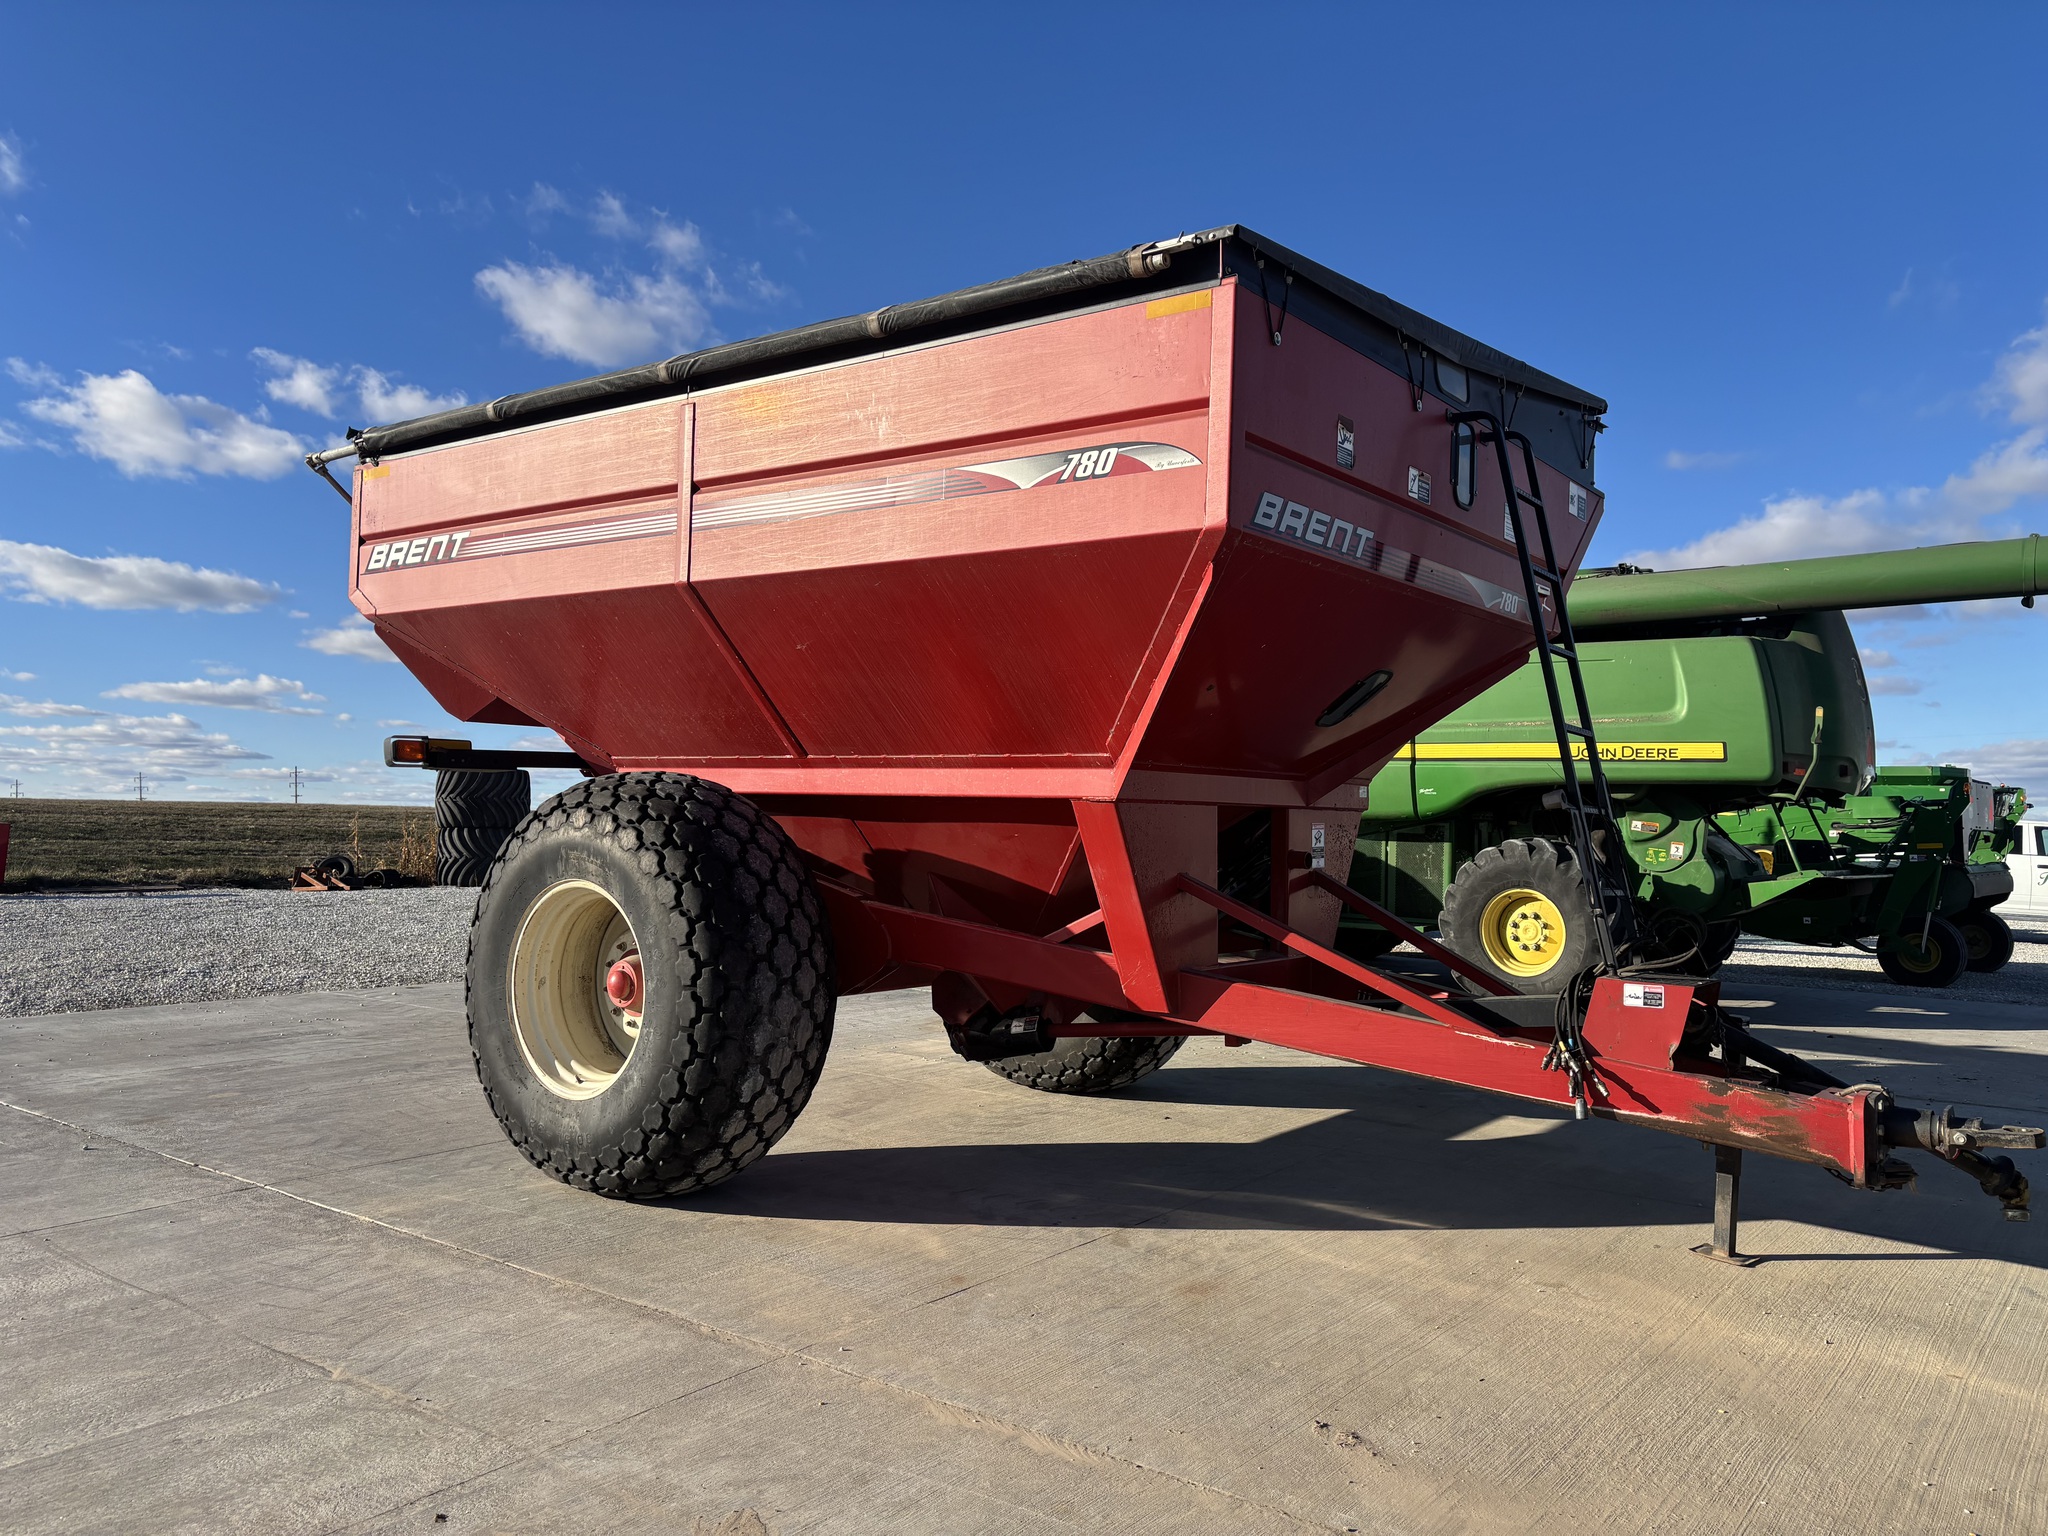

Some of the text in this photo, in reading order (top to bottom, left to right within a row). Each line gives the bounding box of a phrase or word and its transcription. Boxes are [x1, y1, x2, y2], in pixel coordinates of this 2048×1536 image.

[1060, 447, 1119, 483] 780
[1253, 491, 1375, 558] BRENT
[367, 531, 471, 570] BRENT
[1499, 591, 1519, 614] 780
[1621, 745, 1679, 758] DEERE
